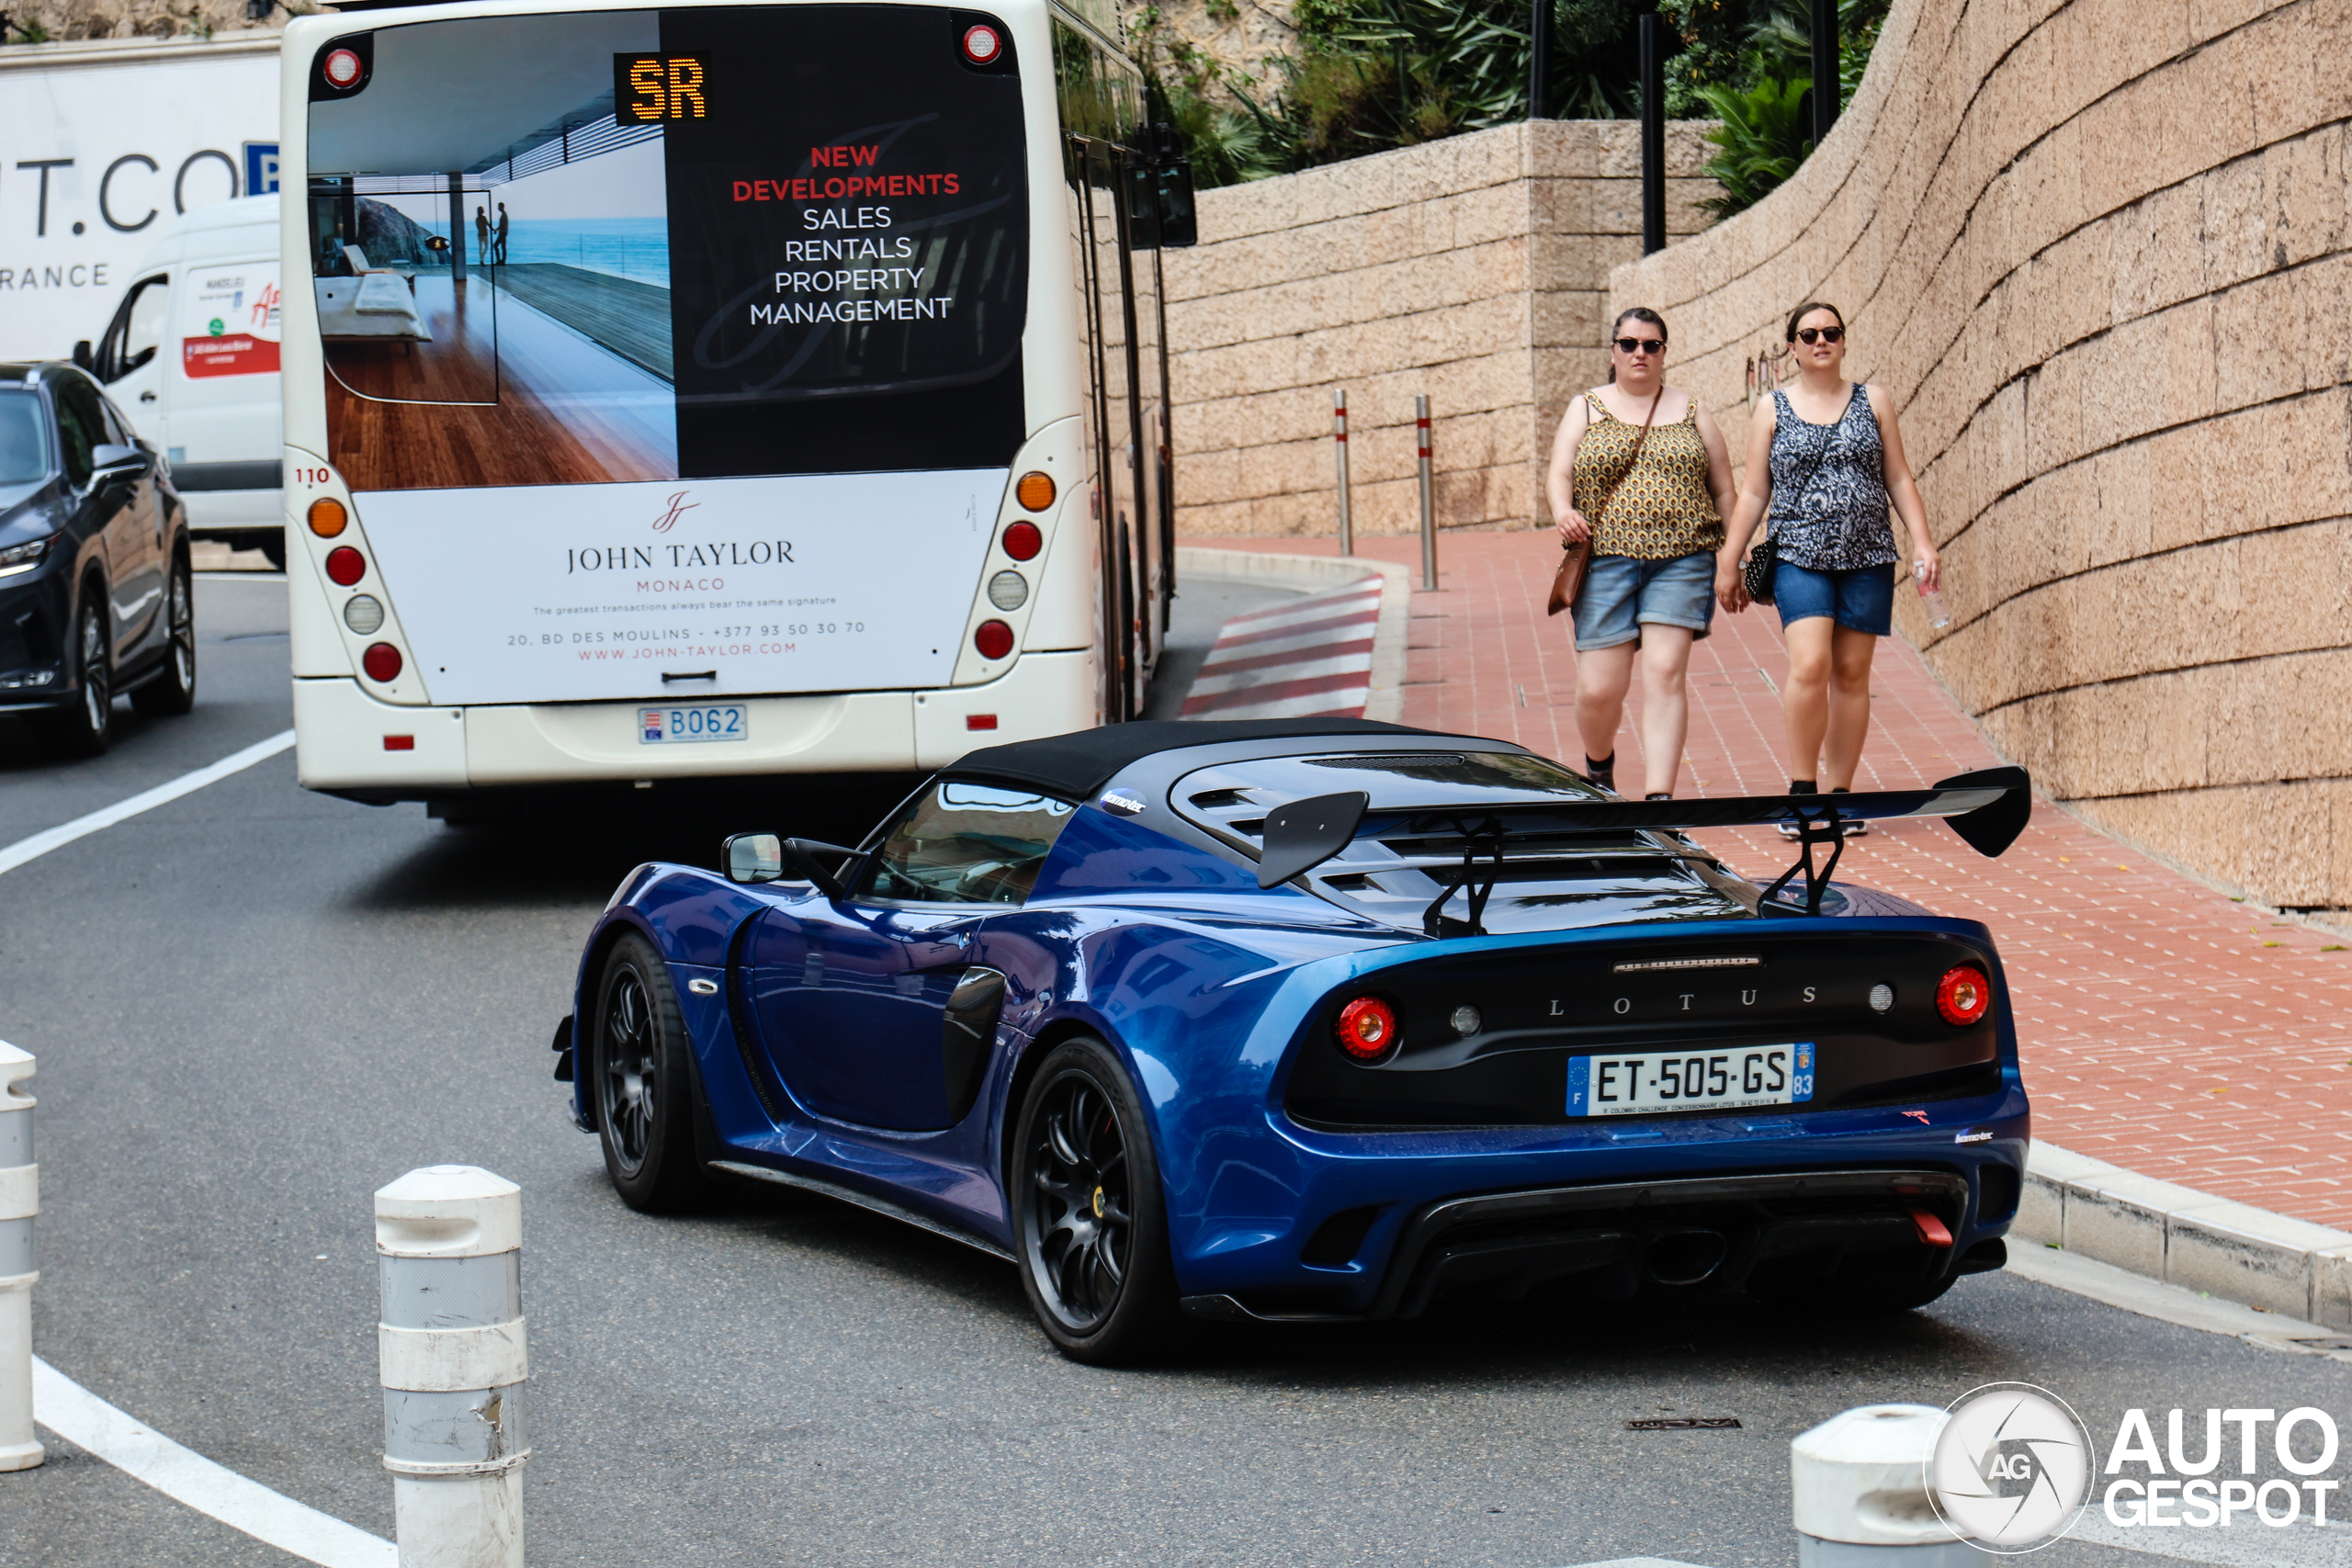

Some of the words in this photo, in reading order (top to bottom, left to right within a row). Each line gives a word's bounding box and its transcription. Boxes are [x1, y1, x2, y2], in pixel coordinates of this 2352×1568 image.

[630, 59, 705, 119] SR
[811, 145, 878, 167] NEW
[733, 174, 960, 201] DEVELOPMENTS
[803, 207, 891, 230] SALES
[786, 236, 912, 262] RENTALS
[775, 267, 925, 293] PROPERTY
[750, 297, 952, 325] MANAGEMENT
[296, 468, 329, 483] 110
[568, 546, 652, 575] JOHN
[666, 540, 795, 568] TAYLOR
[637, 578, 724, 593] MONACO
[533, 606, 552, 615] The
[556, 605, 599, 616] greatest
[603, 603, 667, 613] transactions
[671, 601, 706, 611] always
[709, 601, 732, 610] bear
[736, 600, 753, 608] the
[756, 599, 784, 607] same
[787, 597, 837, 607] signature
[542, 633, 564, 645] BD
[572, 631, 605, 644] DES
[613, 628, 690, 642] MOULINS
[714, 626, 752, 638] +377
[760, 625, 780, 637] 93
[788, 624, 808, 636] 50
[817, 622, 837, 634] 30
[845, 621, 865, 633] 70
[578, 642, 796, 660] WWW.JOHN-TAYLOR.COM
[671, 708, 740, 734] B062
[1549, 986, 1816, 1016] LOTUS
[1793, 1074, 1814, 1095] 83
[1573, 1092, 1582, 1105] F
[1638, 1105, 1668, 1113] CHALLENGE
[1672, 1102, 1717, 1111] CONCESSIONNAIRE
